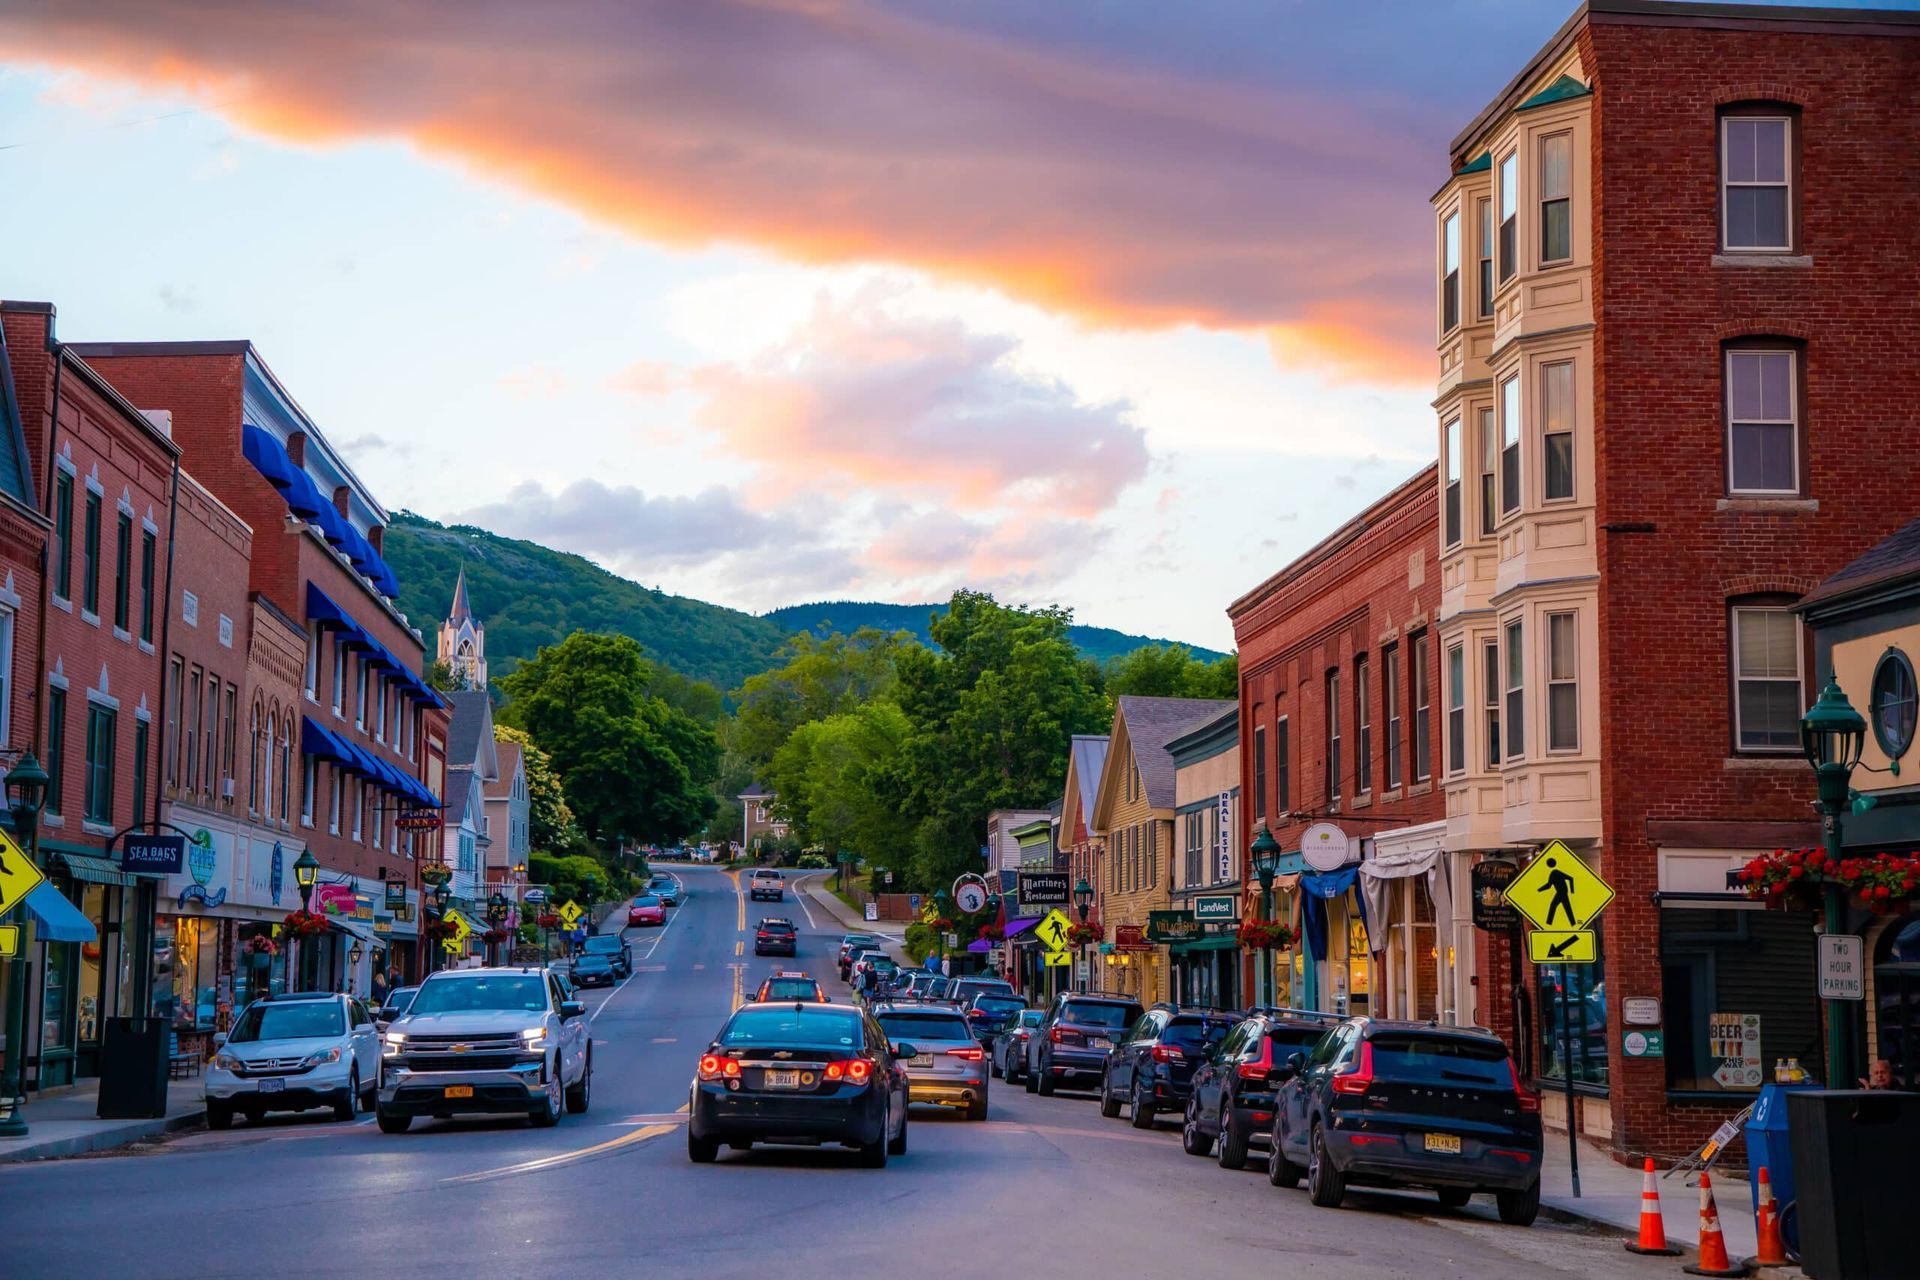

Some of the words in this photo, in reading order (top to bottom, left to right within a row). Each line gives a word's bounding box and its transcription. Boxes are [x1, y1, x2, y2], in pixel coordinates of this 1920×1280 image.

[1221, 793, 1229, 822] REAL
[130, 846, 148, 860] SEA
[150, 846, 177, 862] BAGS
[1221, 831, 1229, 876] ESTATE
[1022, 877, 1067, 891] Marriner's
[1025, 890, 1065, 901] Restaurant
[1199, 902, 1229, 912] LandVest
[1833, 943, 1849, 956] TWO
[1830, 961, 1852, 973] HOUR
[1824, 978, 1859, 991] PARKING
[1711, 1024, 1742, 1039] BEER
[1411, 1089, 1479, 1101] VOLVO
